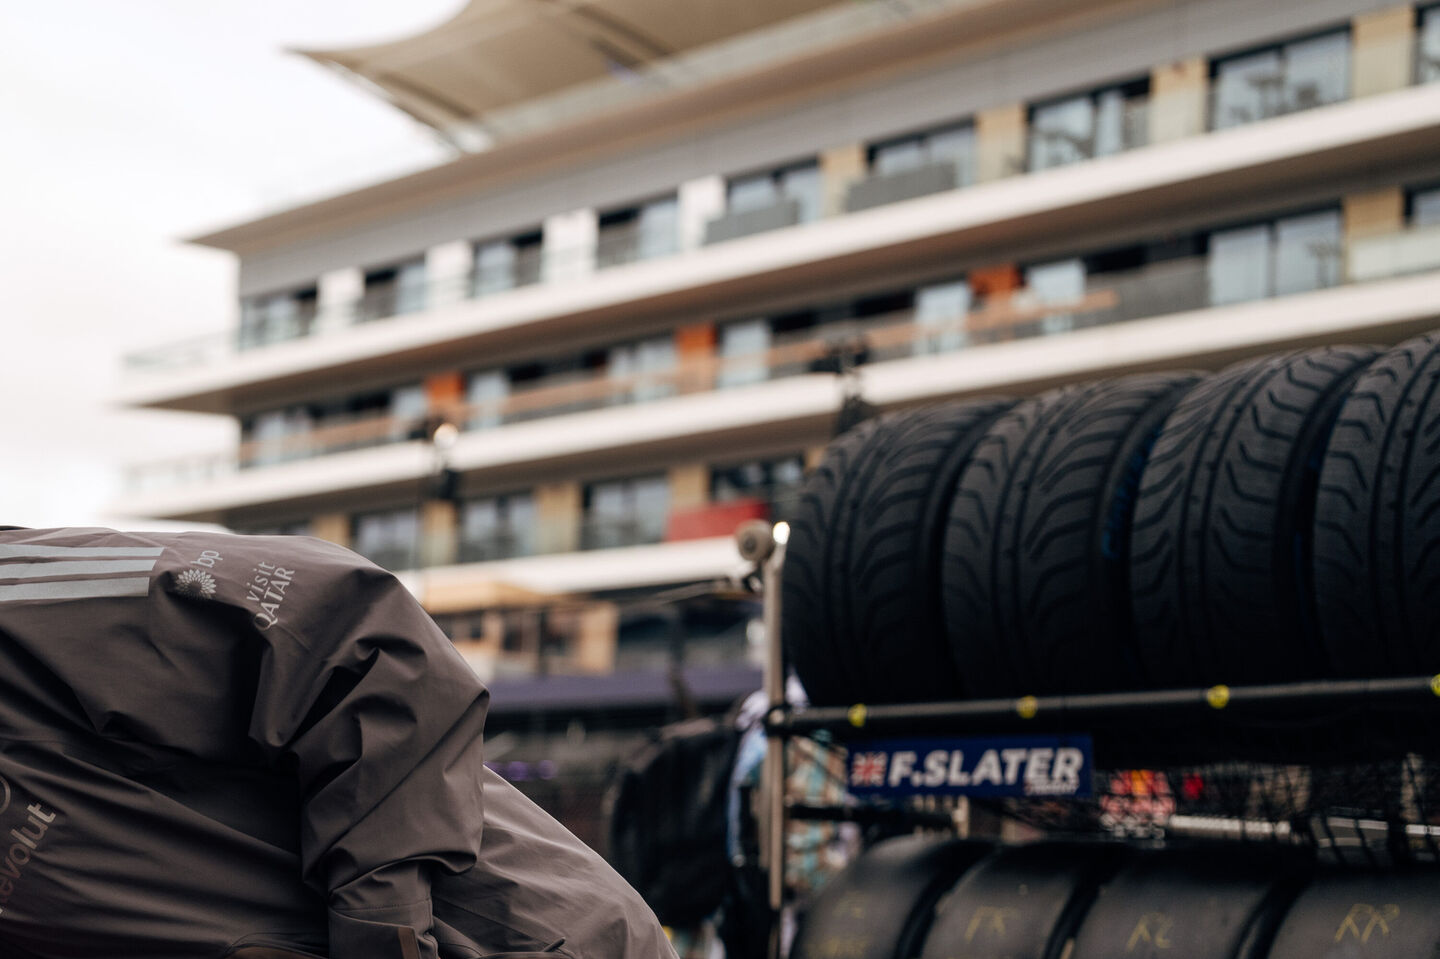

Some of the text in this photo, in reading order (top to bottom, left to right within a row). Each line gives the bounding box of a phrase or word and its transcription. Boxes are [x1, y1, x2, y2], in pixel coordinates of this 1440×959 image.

[190, 550, 223, 568] bp
[246, 561, 275, 602] visit
[254, 567, 295, 631] QATAR
[888, 747, 1084, 788] F.SLATER
